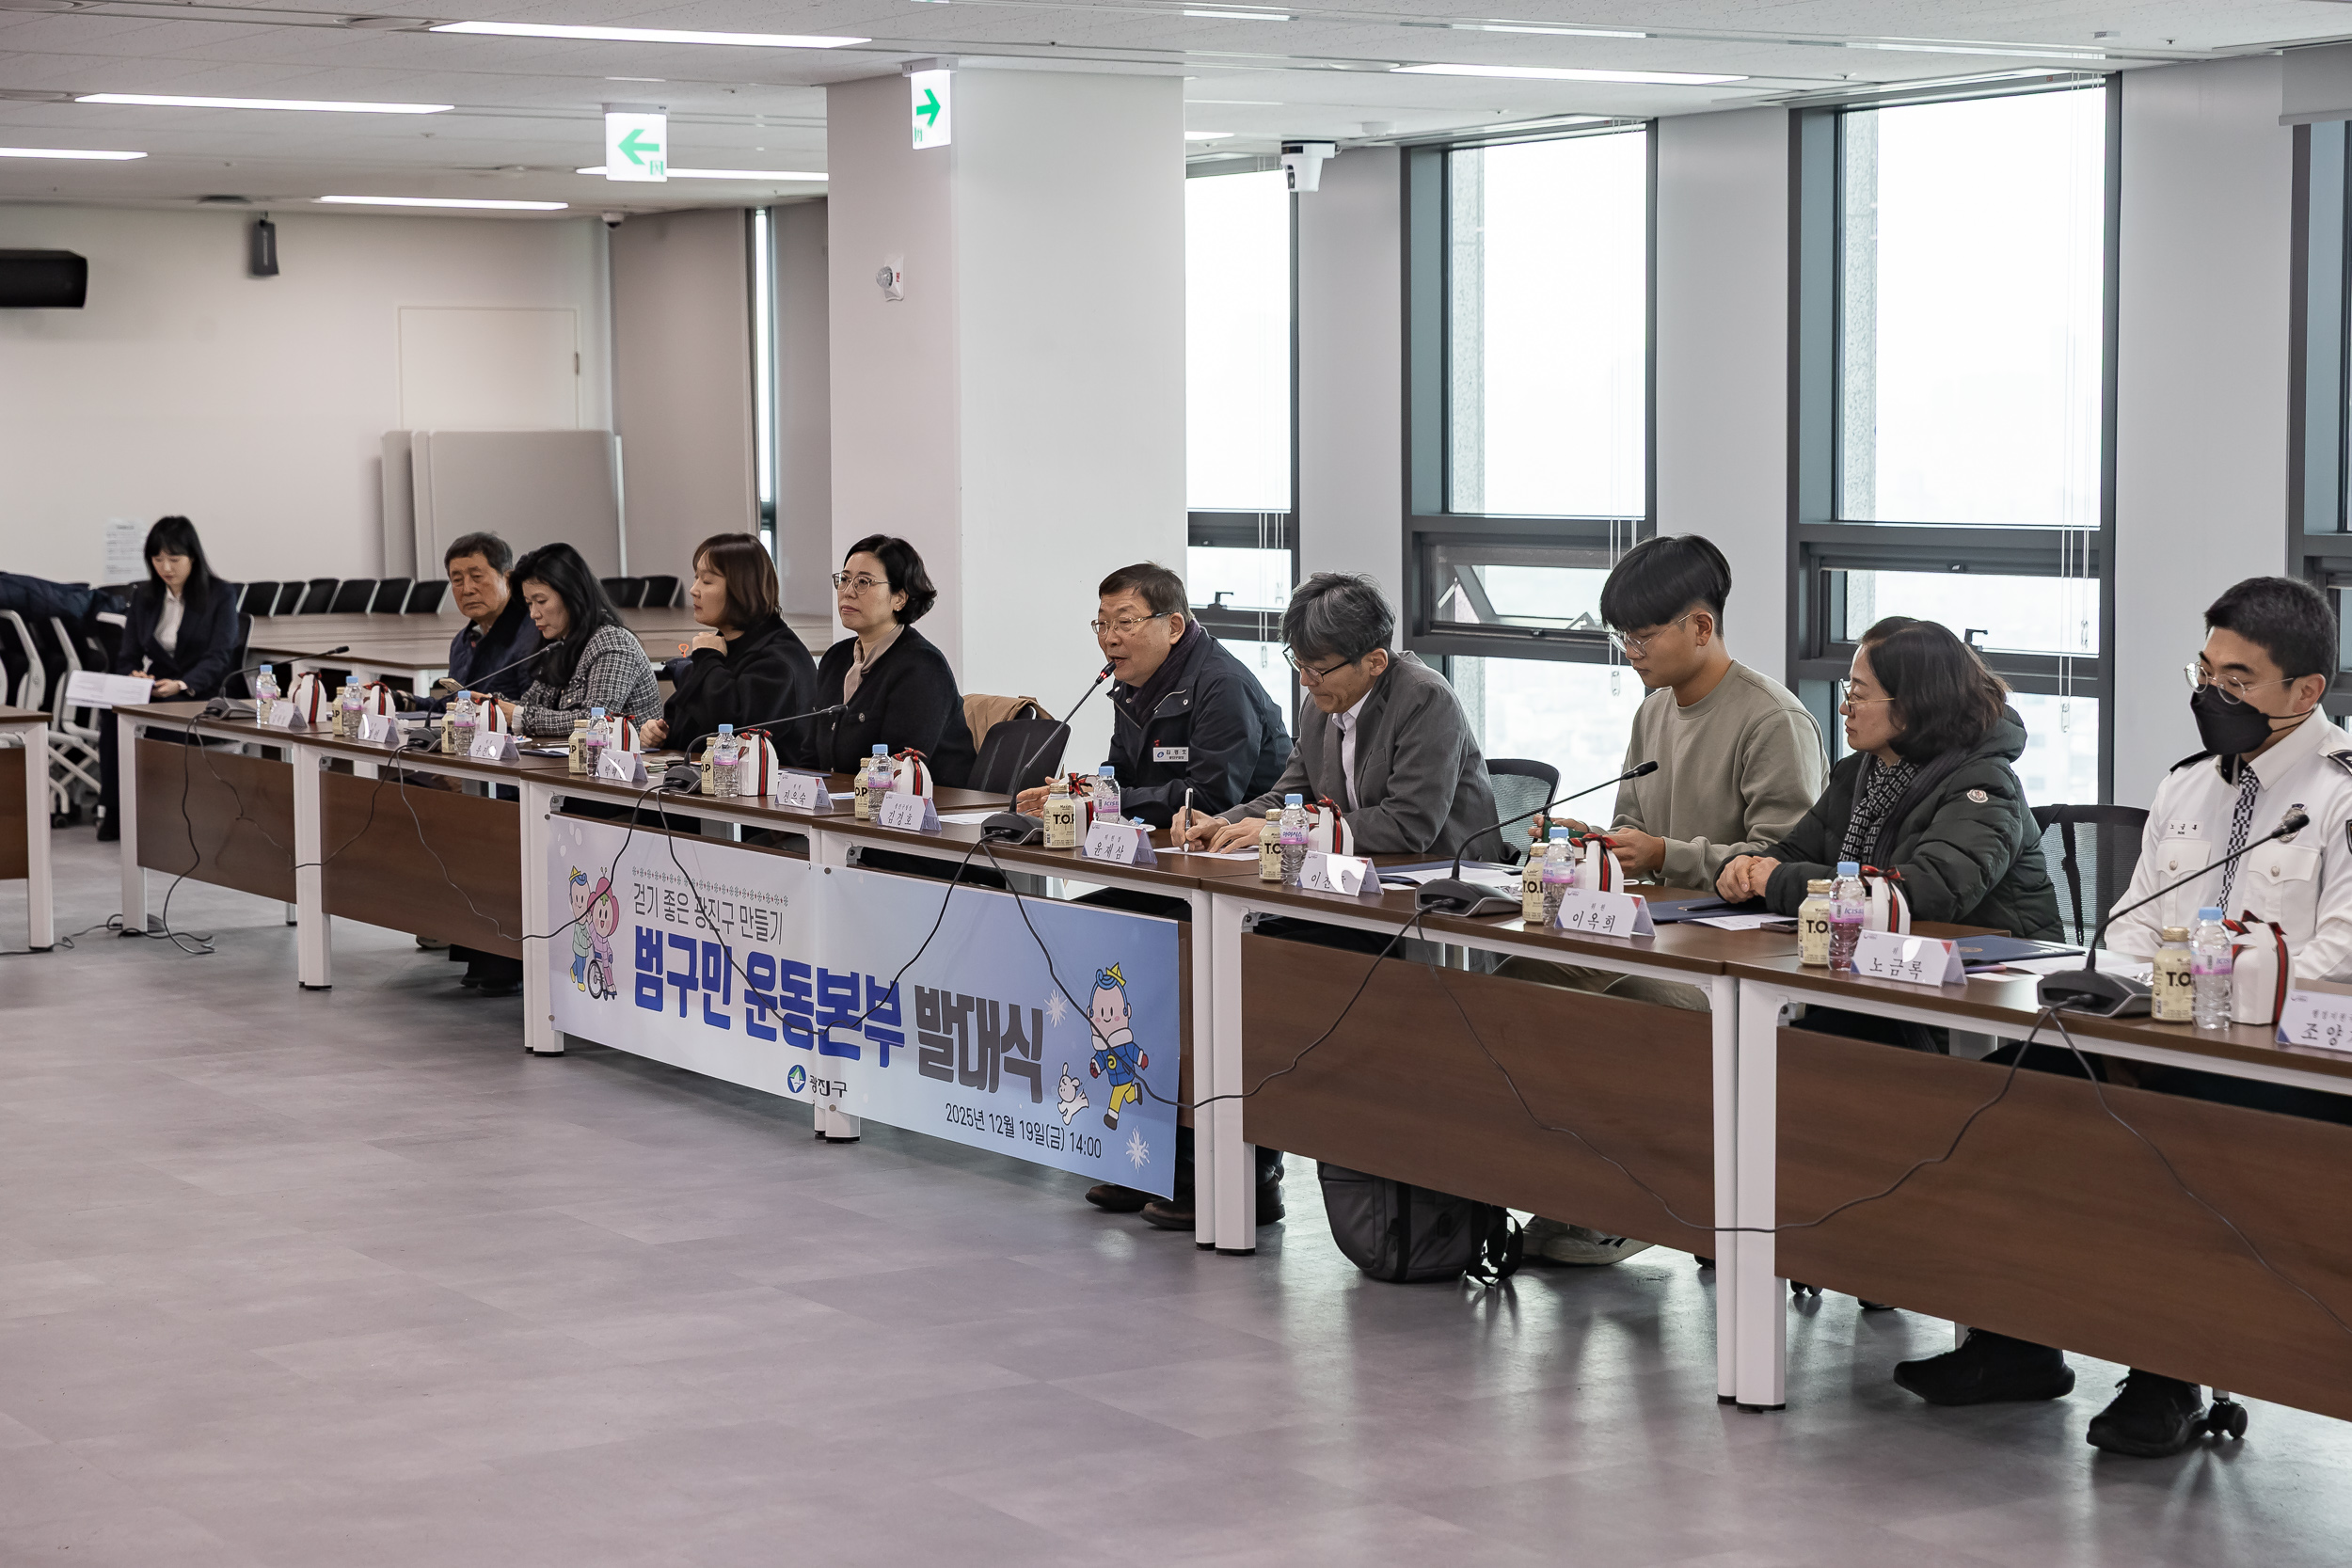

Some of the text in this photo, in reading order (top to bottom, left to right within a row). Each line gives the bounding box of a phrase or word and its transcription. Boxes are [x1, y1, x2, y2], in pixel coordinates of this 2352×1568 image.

[888, 810, 913, 826] 김경호
[633, 882, 783, 945] 걷기 좋은 광진구 만들기
[1572, 911, 1616, 933] 이옥희
[1869, 957, 1923, 980] 노금록
[634, 925, 1043, 1103] 범구민 운동본부 발대식
[2301, 1022, 2352, 1046] 조양
[809, 1074, 848, 1099] 광진구
[946, 1102, 1102, 1159] 2025년 12월 19일(금) 14:00
